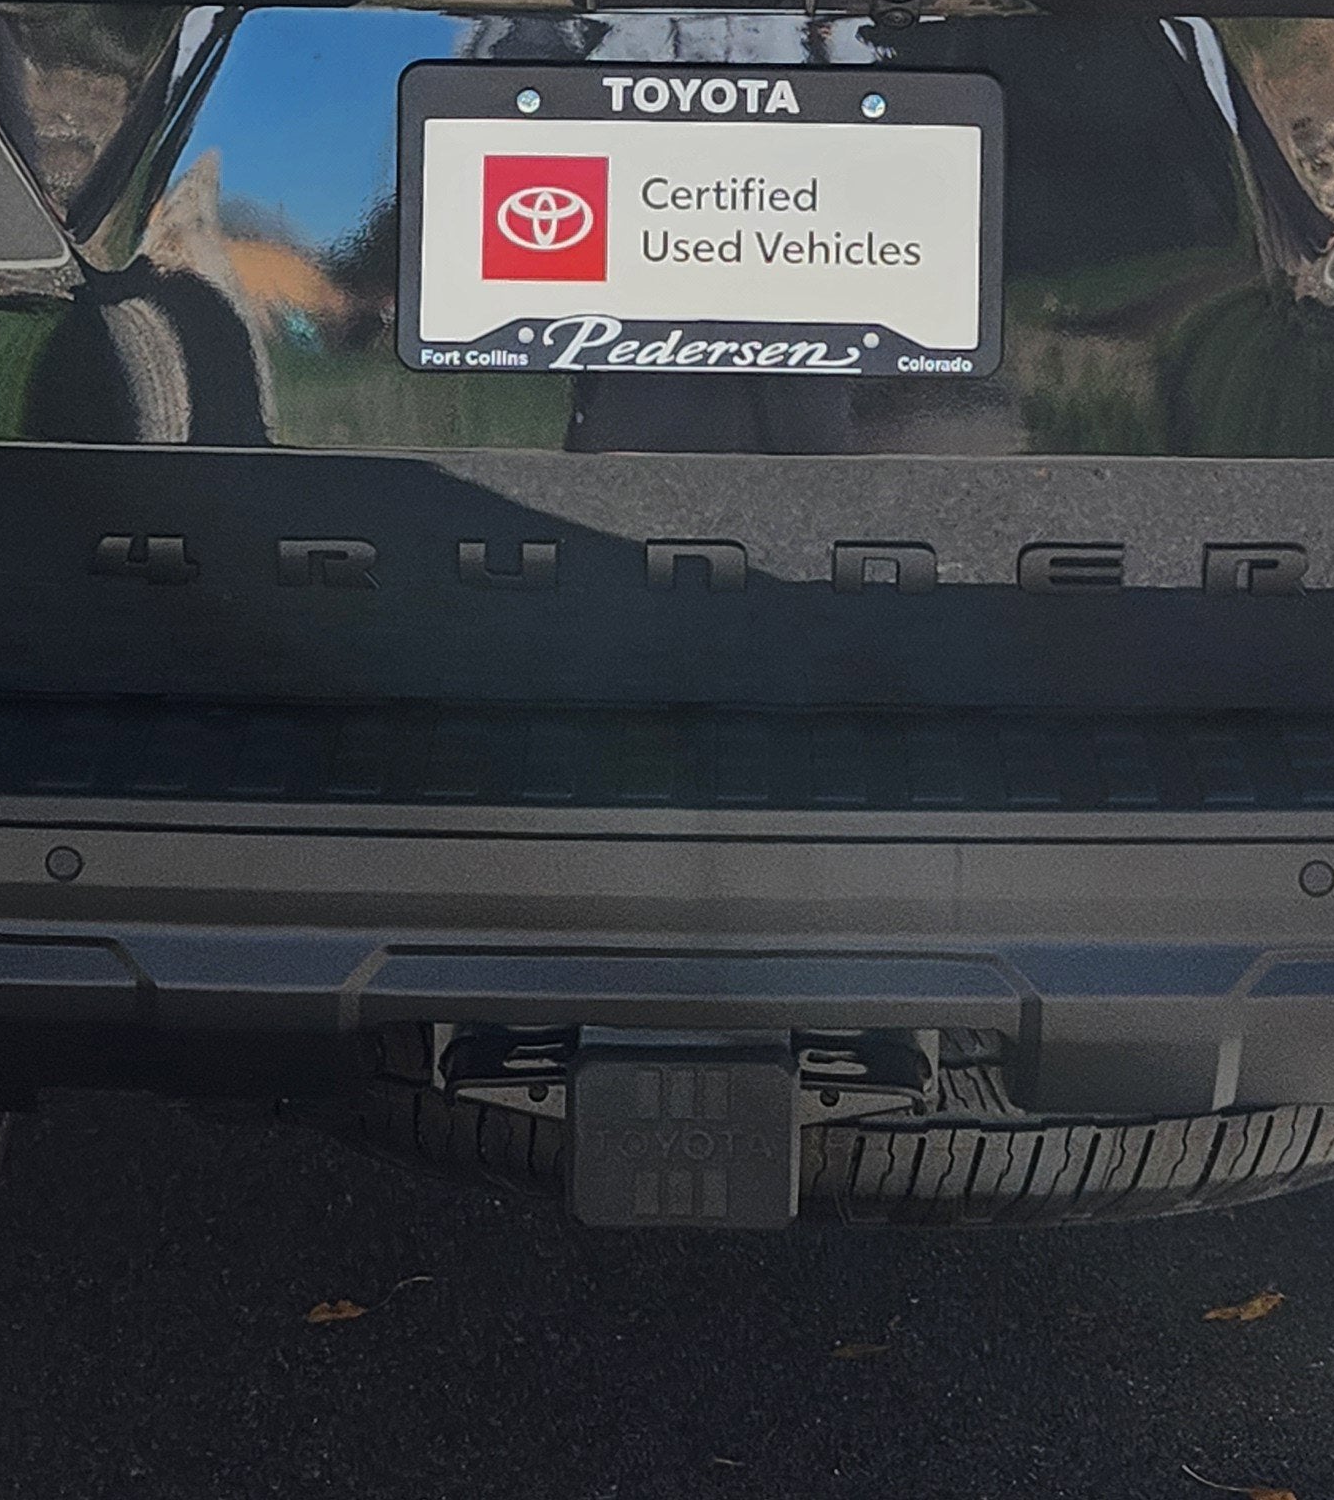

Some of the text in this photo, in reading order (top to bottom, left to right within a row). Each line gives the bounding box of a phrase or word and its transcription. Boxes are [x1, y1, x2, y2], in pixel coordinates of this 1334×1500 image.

[602, 76, 800, 115] TOYOTA
[640, 176, 819, 213] Certified
[641, 229, 922, 267] Used Vehicles
[420, 348, 530, 367] Fort Collins
[542, 315, 861, 371] Pedersen
[896, 354, 974, 373] Colorado
[596, 1127, 774, 1161] TOYOTA
